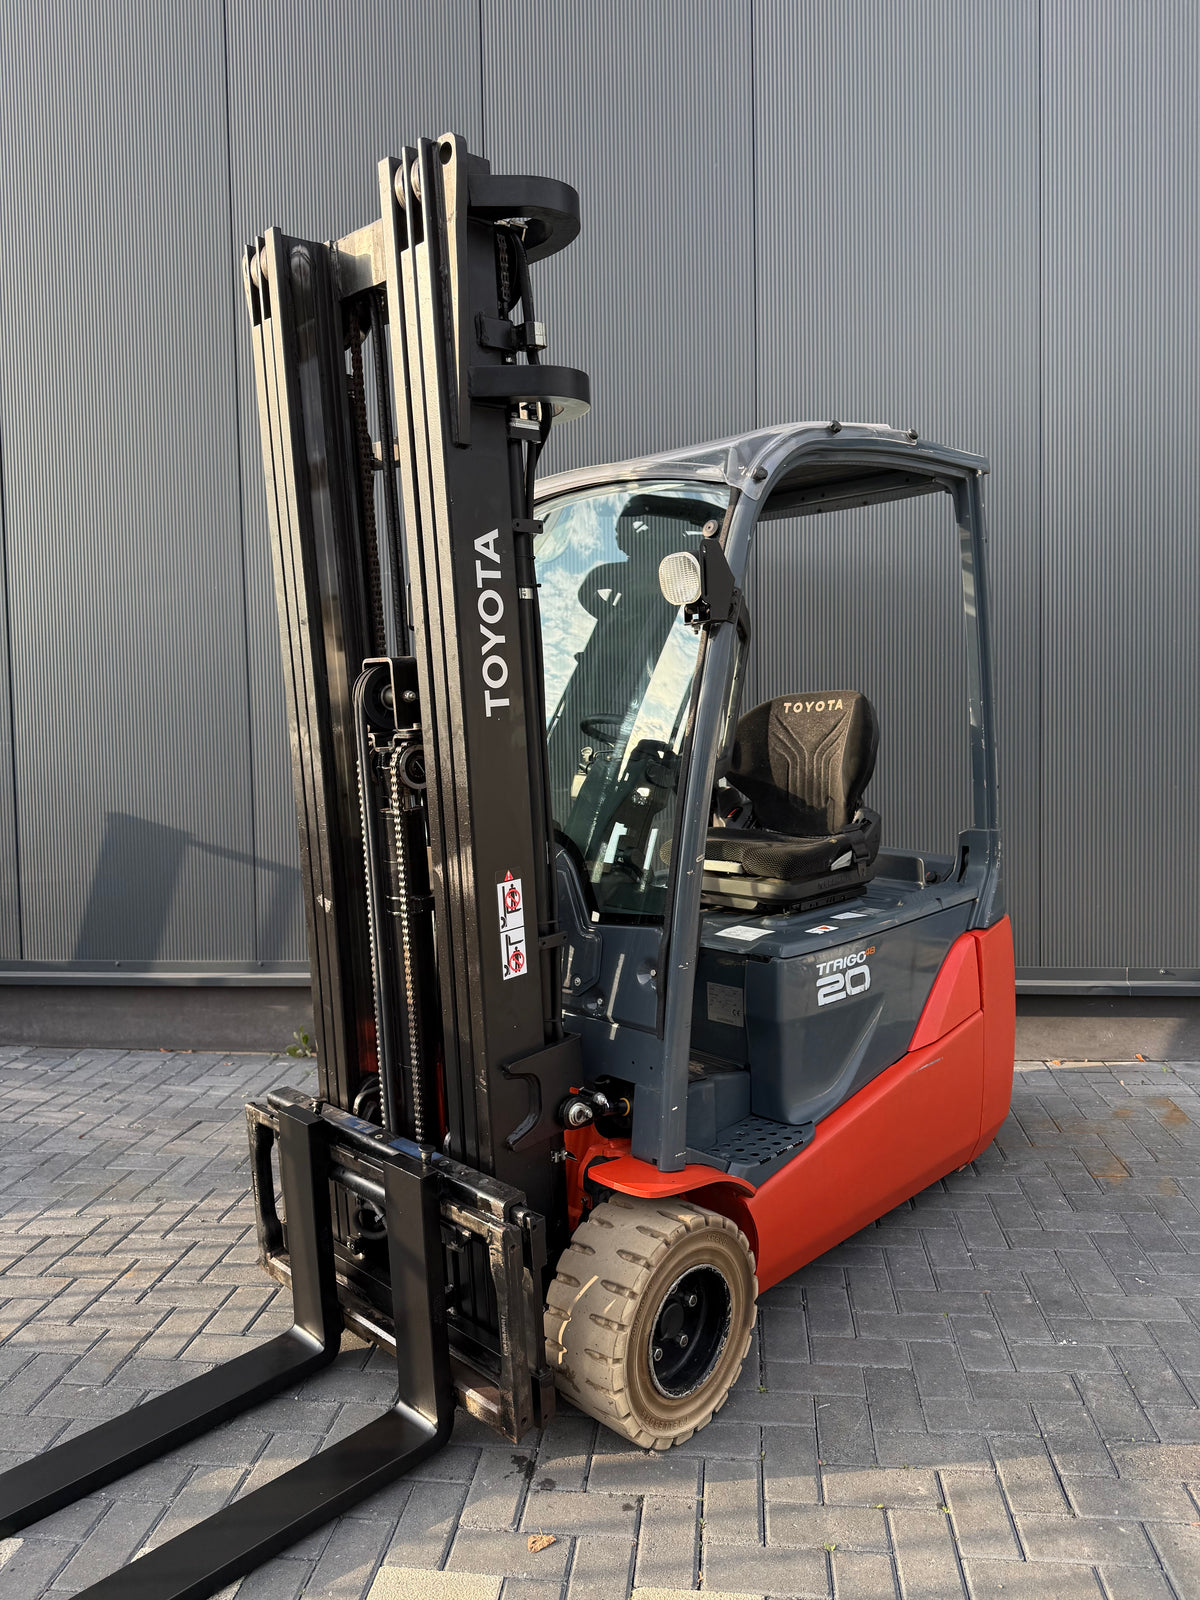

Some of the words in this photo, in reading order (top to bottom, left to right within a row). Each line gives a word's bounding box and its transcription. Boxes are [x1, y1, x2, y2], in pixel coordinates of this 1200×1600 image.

[473, 528, 510, 718] TOYOTA
[783, 699, 843, 714] TOYOTA
[816, 964, 871, 1007] 20
